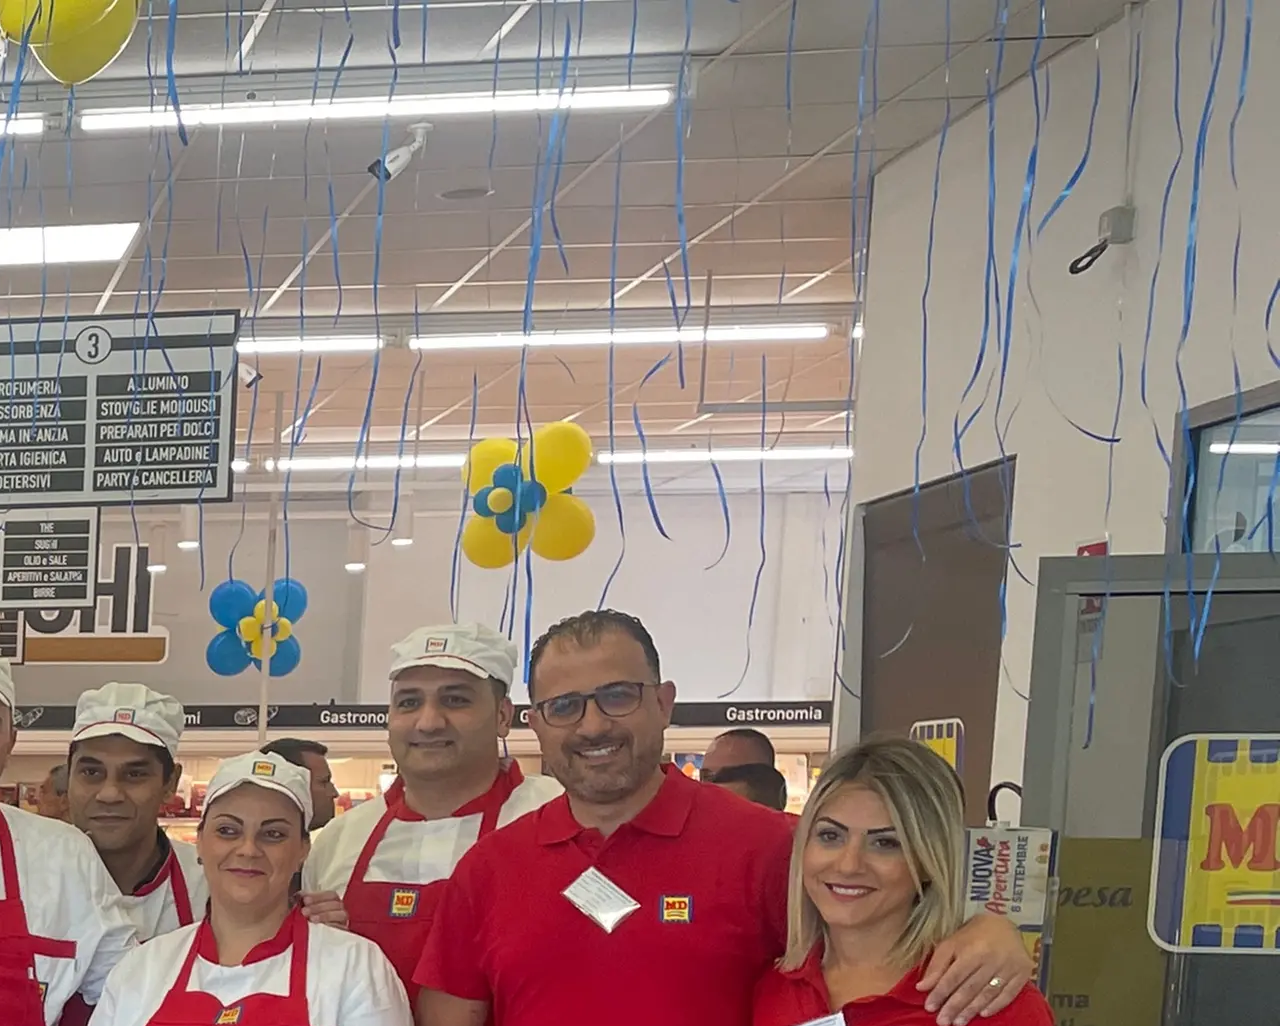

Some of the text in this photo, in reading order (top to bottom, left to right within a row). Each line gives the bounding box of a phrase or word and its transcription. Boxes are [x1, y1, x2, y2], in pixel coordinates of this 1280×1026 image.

[88, 333, 99, 358] 3
[100, 422, 157, 439] PREPARATI
[183, 420, 214, 436] DOLCI
[19, 451, 67, 466] IGIENICA
[103, 447, 132, 462] AUTO
[145, 446, 210, 461] LAMPADINE
[97, 471, 130, 487] PARTY
[142, 469, 213, 486] CANCELLERIA
[40, 523, 54, 533] THE
[24, 555, 40, 566] OLIO
[48, 555, 68, 565] SALE
[726, 707, 823, 722] Gastronomia
[970, 842, 995, 902] NUOVA
[1013, 836, 1028, 903] SETTEMBRE
[395, 894, 413, 907] MD
[665, 900, 687, 910] MD
